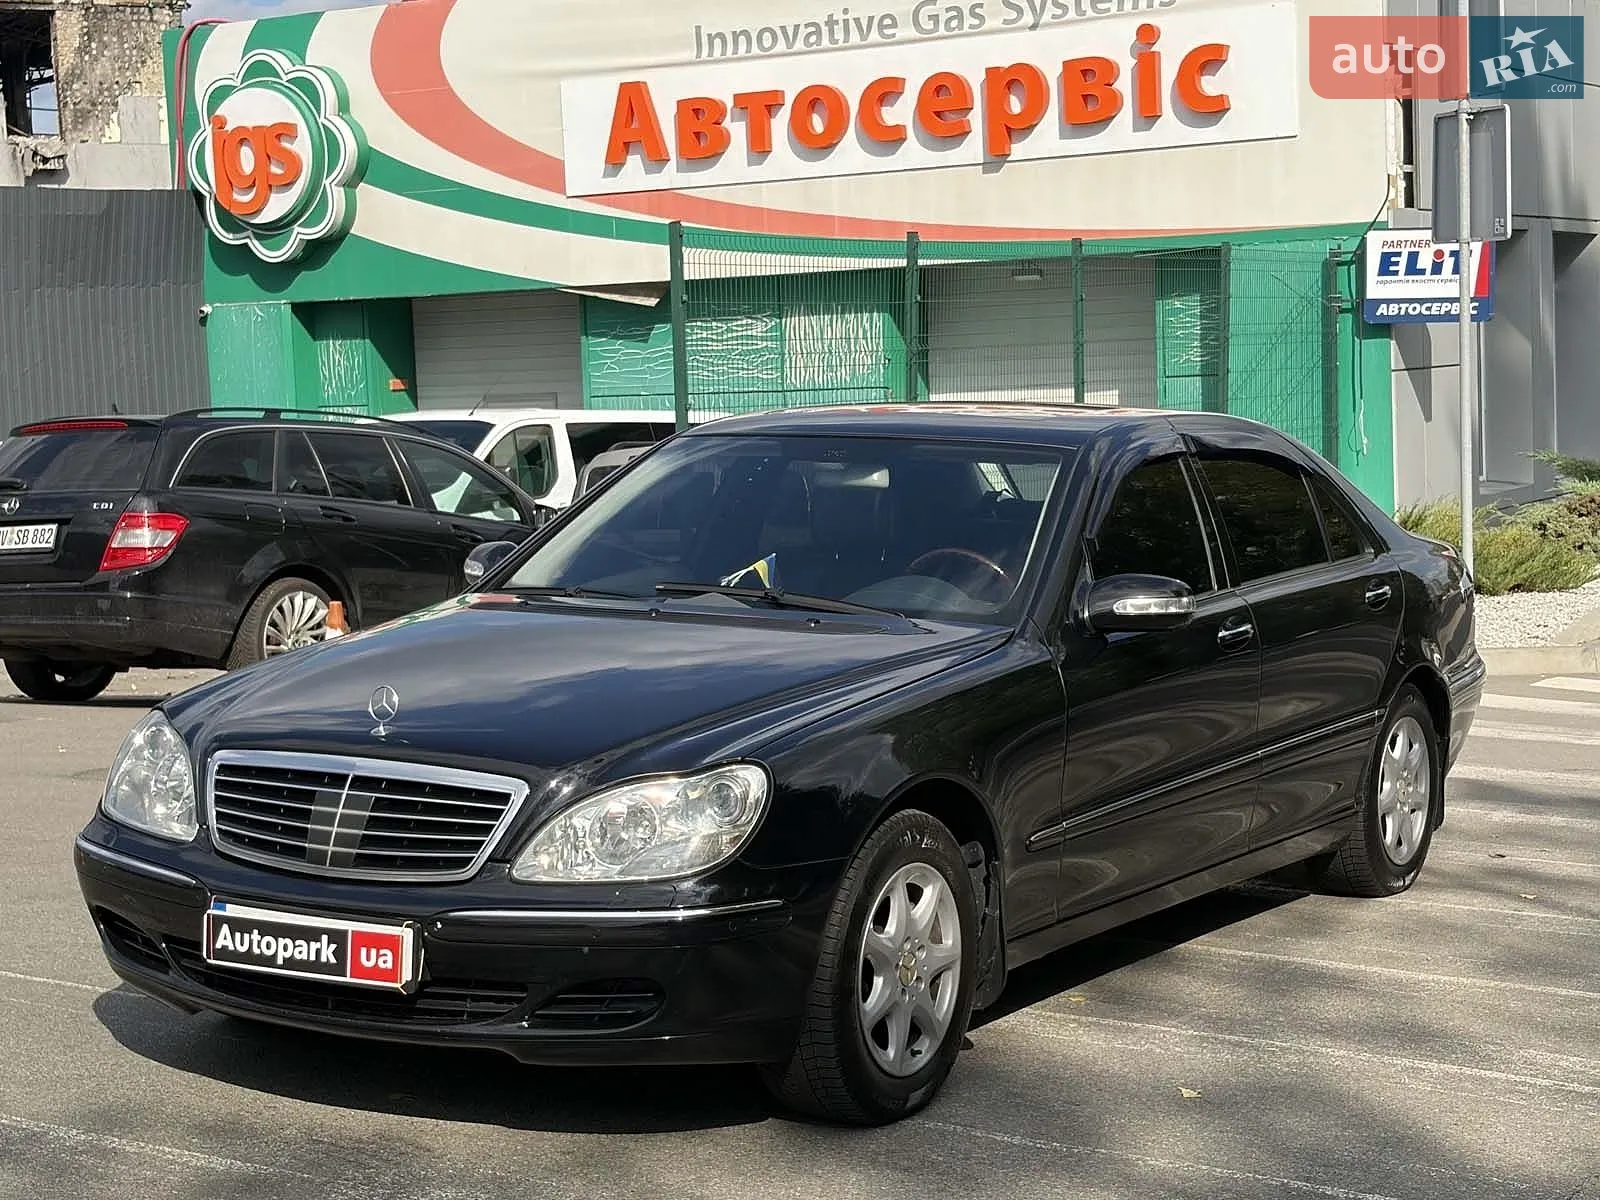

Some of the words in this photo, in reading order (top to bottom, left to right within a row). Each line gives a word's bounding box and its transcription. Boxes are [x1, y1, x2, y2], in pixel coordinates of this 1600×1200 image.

[694, 8, 898, 59] Innovative
[912, 0, 986, 35] Gas
[1001, 0, 1176, 31] Syste
[604, 23, 1231, 165] Автосервіс
[1381, 239, 1432, 249] PARTNER
[1376, 302, 1479, 316] АВТОСЕРВС
[92, 502, 114, 510] CDI
[0, 529, 9, 546] V
[14, 528, 30, 545] SB
[31, 527, 54, 545] 882
[215, 923, 338, 965] Autopark
[359, 946, 394, 970] ua
